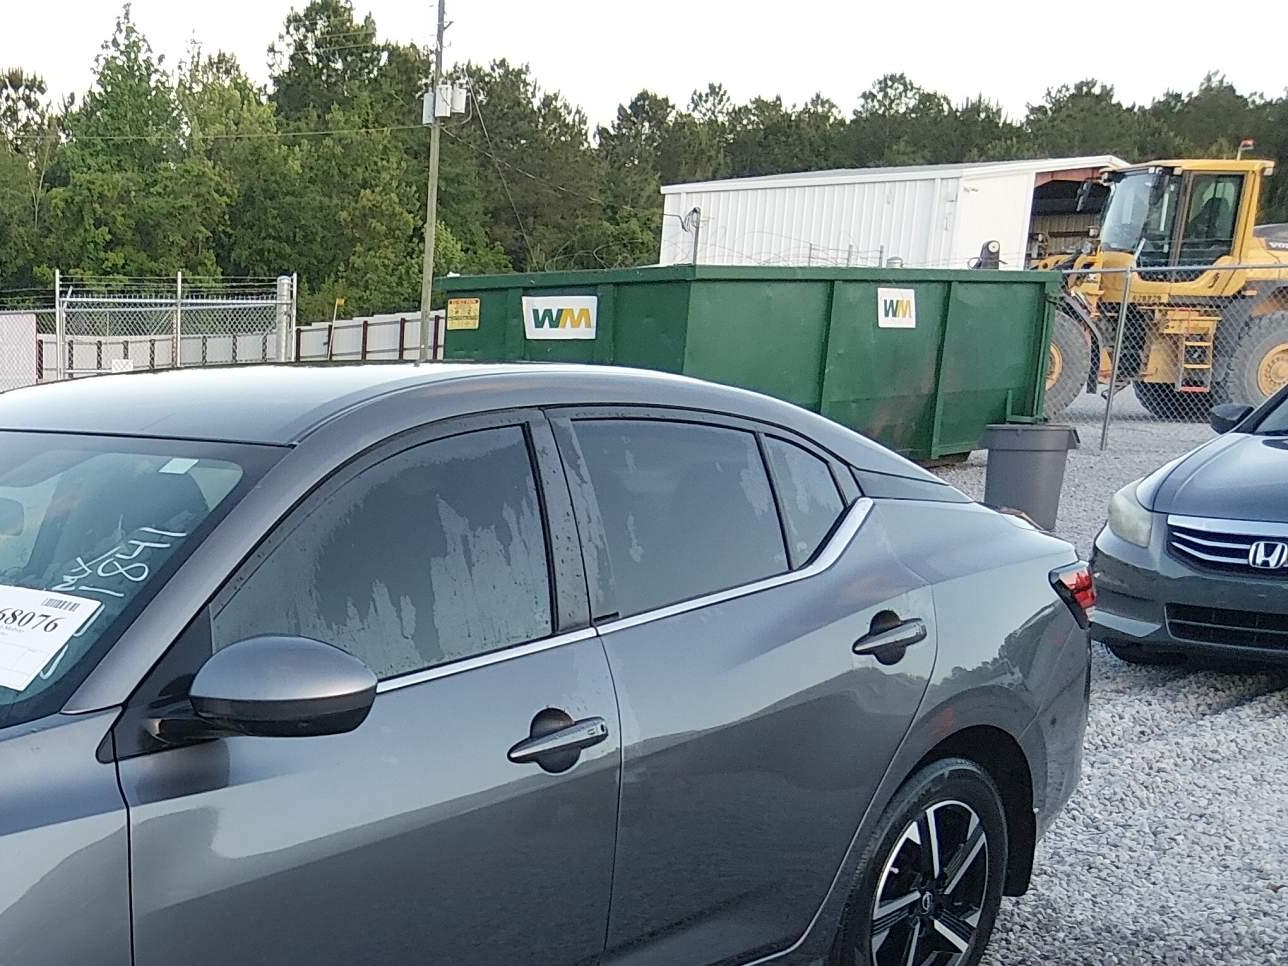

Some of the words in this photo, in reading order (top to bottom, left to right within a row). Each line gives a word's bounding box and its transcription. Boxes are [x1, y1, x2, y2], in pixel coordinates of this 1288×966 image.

[532, 307, 592, 329] WM
[883, 299, 912, 318] WM
[78, 526, 188, 597] 1841
